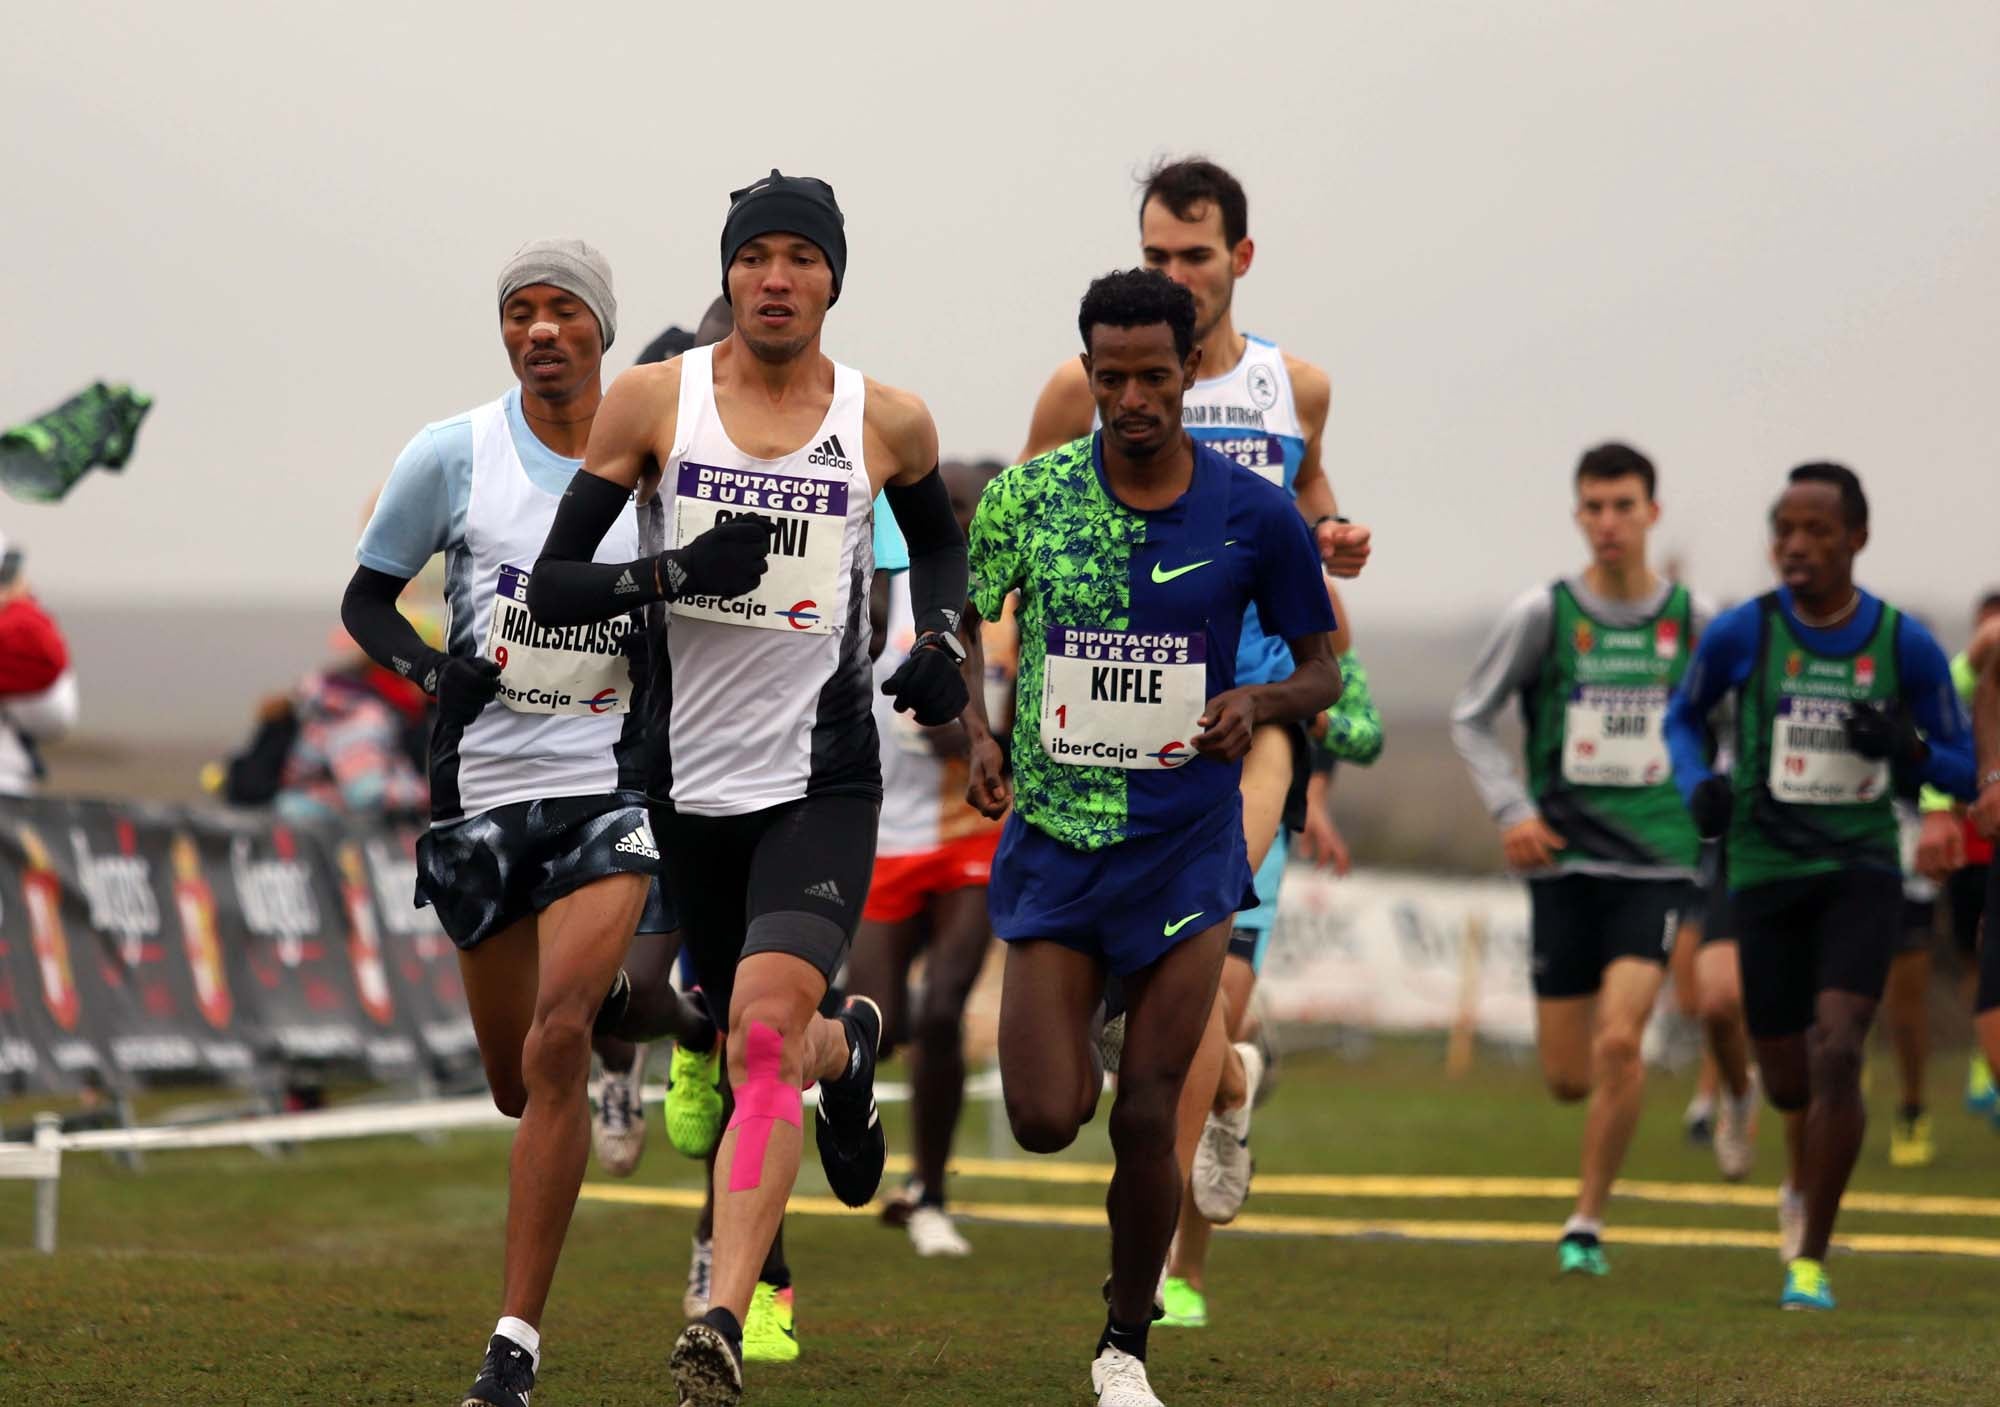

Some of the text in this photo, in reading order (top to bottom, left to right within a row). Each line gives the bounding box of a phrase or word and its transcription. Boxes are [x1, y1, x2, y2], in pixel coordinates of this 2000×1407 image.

[1211, 438, 1268, 454] ACIÓN
[808, 453, 853, 471] adidas
[698, 468, 830, 497] DIPUTACIÓN
[696, 483, 829, 514] BURGOS
[682, 594, 767, 620] berCaja
[1064, 630, 1189, 649] DIPUTACIÓN
[495, 646, 508, 671] 9
[1064, 643, 1189, 664] BURGOS
[497, 679, 571, 709] berCaja
[1091, 666, 1163, 704] KIFLE
[1055, 704, 1067, 729] 1
[1052, 738, 1138, 763] iberCaja
[615, 841, 661, 860] adidas
